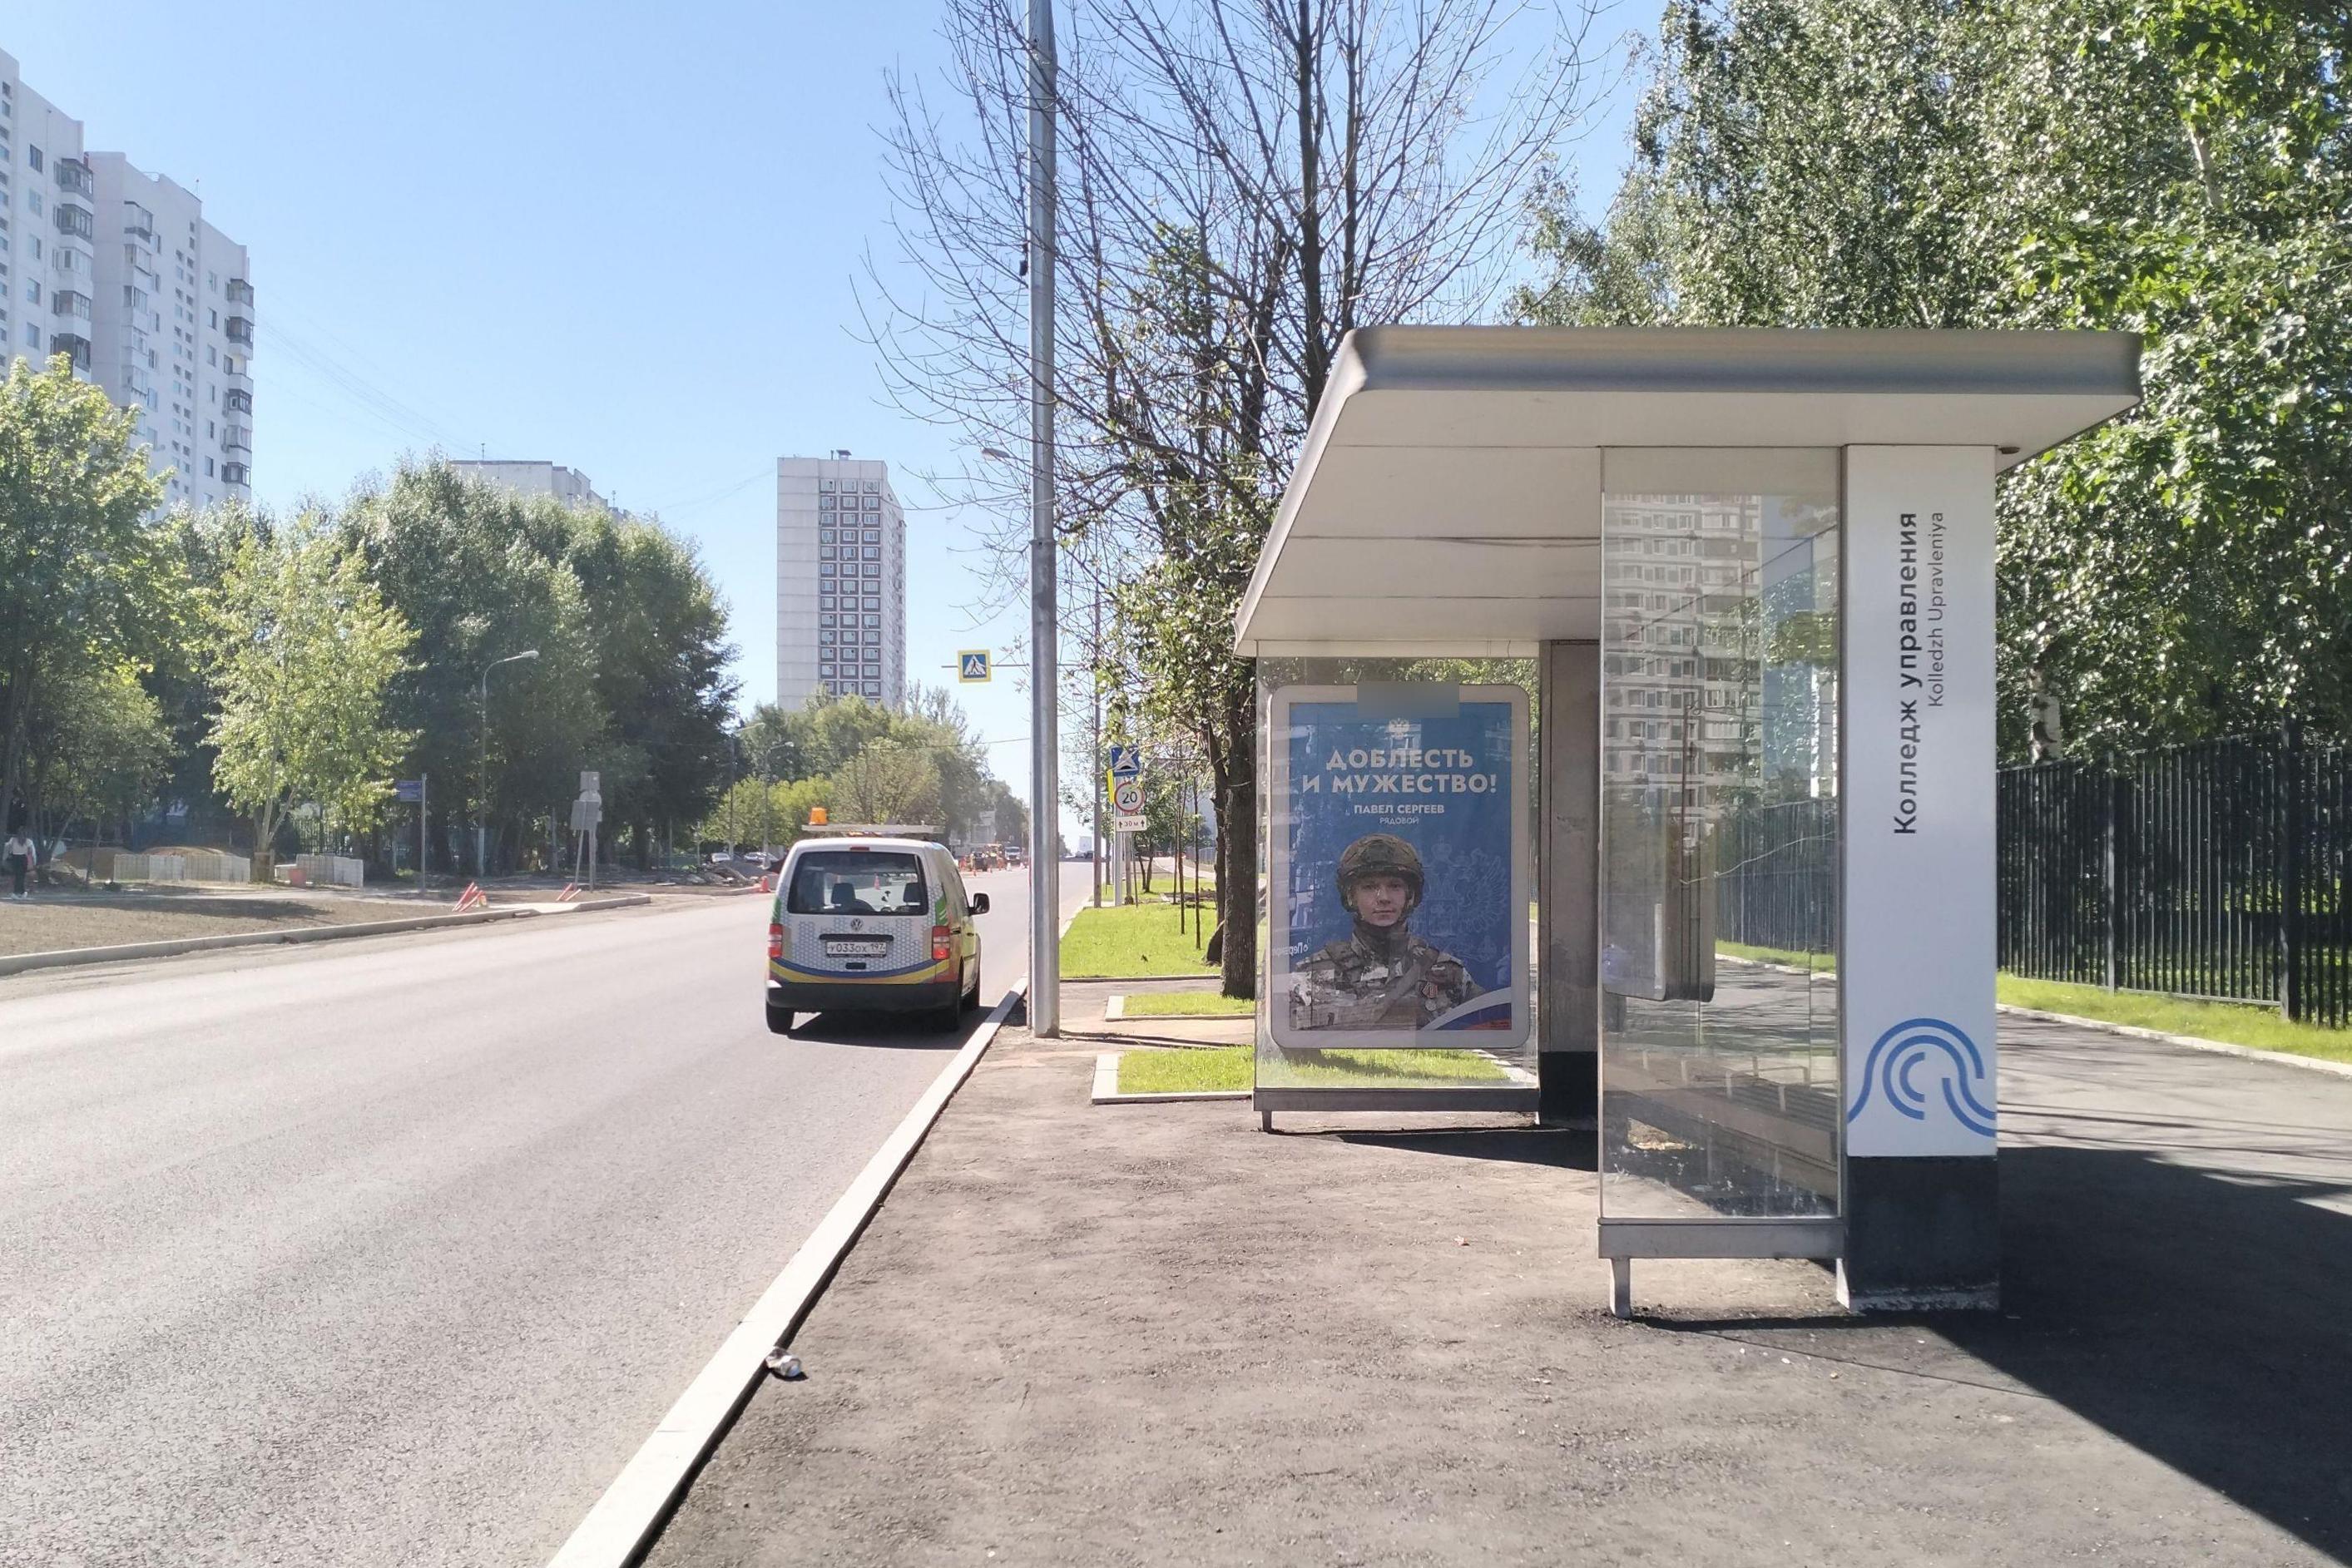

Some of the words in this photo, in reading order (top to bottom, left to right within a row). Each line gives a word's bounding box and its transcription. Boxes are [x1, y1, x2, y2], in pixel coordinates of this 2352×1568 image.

[1927, 512, 1948, 621] Upravleniya
[1899, 512, 1923, 688] управления
[1927, 627, 1944, 707] Kolledzh
[1325, 749, 1473, 770] ДОБЛЕСТЬ
[1894, 700, 1921, 834] Колледж
[1302, 774, 1320, 794] И
[1331, 774, 1497, 794] МУЖЕСТВО!
[1122, 791, 1137, 804] 20
[1354, 804, 1394, 814] ПАВЕЛ
[1397, 804, 1445, 814] СЕРГЕЕВ
[1379, 817, 1419, 825] РЯДОВОЙ
